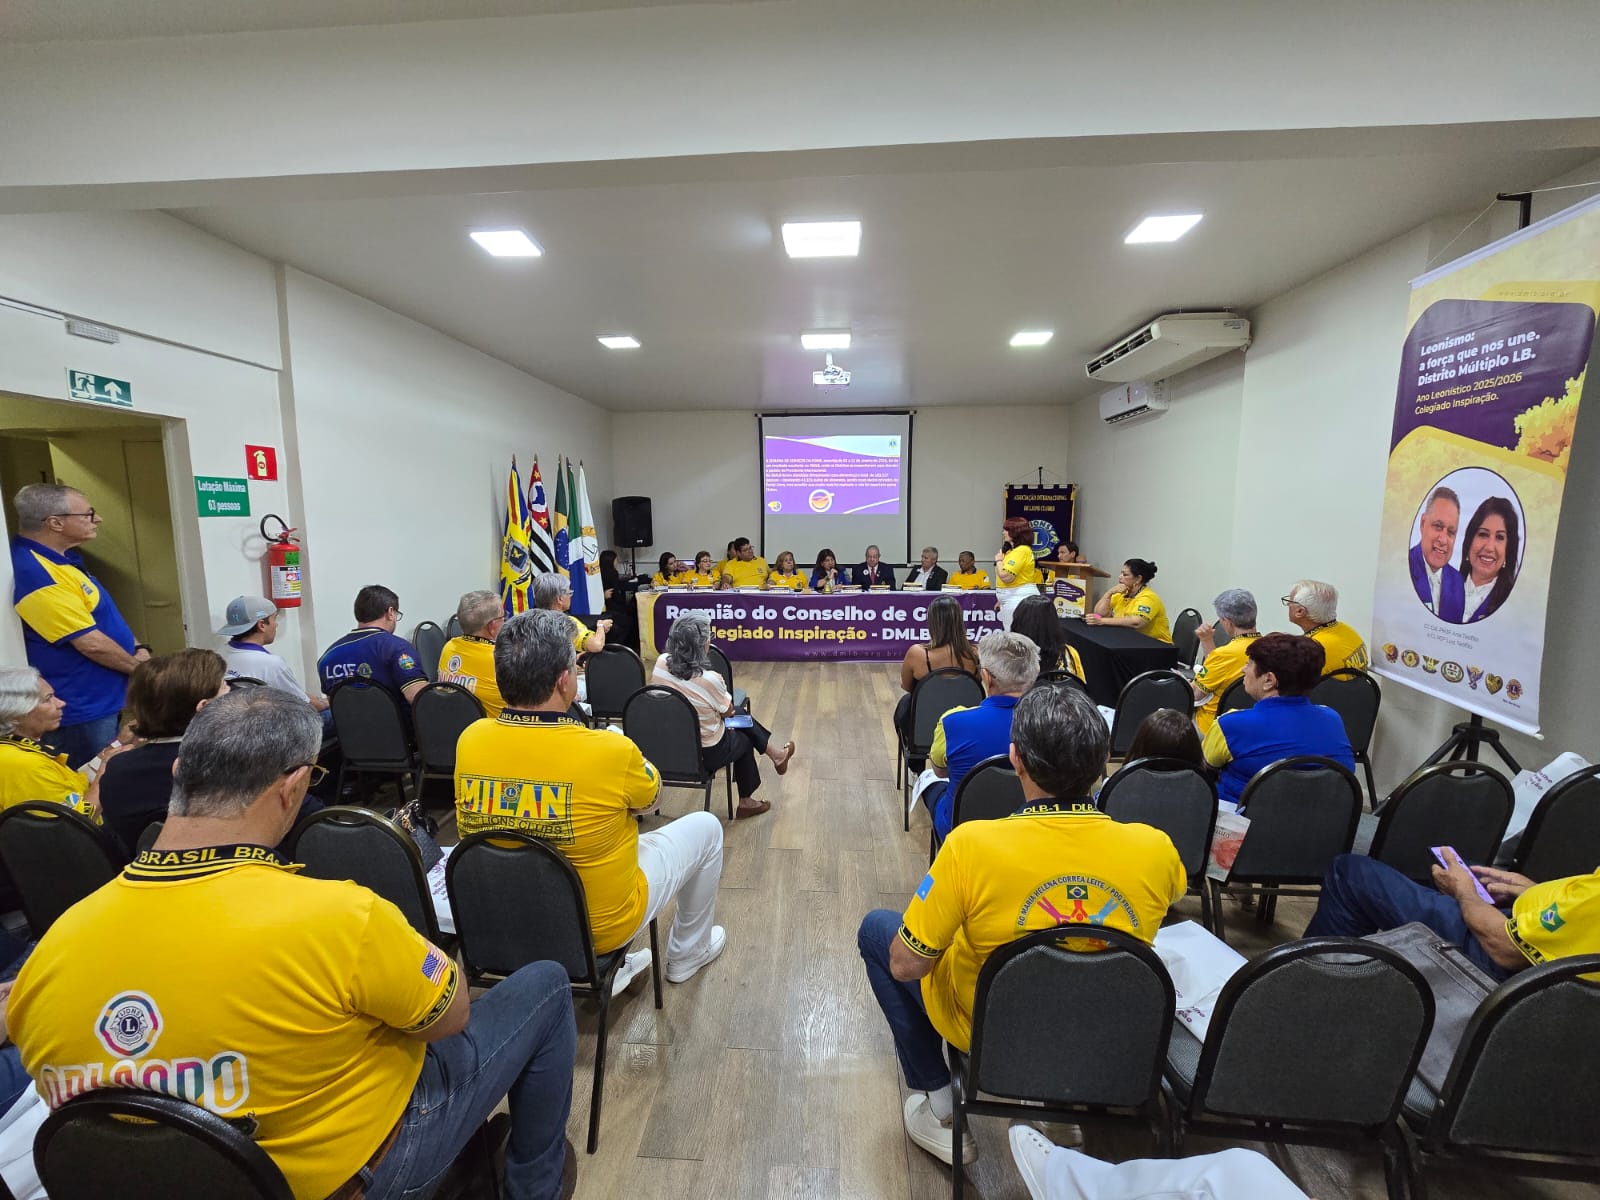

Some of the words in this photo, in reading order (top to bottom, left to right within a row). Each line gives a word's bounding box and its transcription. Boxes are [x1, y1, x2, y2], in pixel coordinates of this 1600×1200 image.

[1419, 362, 1426, 371] a
[1427, 354, 1454, 370] força
[1457, 347, 1479, 363] que
[1481, 339, 1504, 353] nos
[1507, 330, 1541, 346] une.
[1421, 331, 1475, 356] Leonismo:
[1417, 368, 1456, 386] Distrito
[1458, 354, 1509, 376] Múltiplo
[1512, 348, 1536, 364] LB.
[1416, 394, 1430, 403] Ano
[1431, 384, 1472, 399] Leonístico
[1473, 371, 1523, 391] 2025/2026
[1415, 401, 1451, 415] Colegiado
[1452, 392, 1499, 408] Inspiração.
[198, 480, 223, 494] Lotação
[223, 482, 246, 492] Máxima
[208, 500, 217, 511] 63
[217, 502, 241, 512] pessoas
[1030, 520, 1052, 530] IONS
[666, 604, 746, 620] Renião
[752, 606, 777, 620] do
[782, 606, 876, 621] Conselho
[882, 606, 907, 621] de
[711, 625, 774, 641] legiado
[778, 626, 867, 643] Inspiração
[325, 664, 357, 679] LCIF
[501, 712, 540, 722] BRASIL
[461, 778, 563, 818] MILAN
[1023, 804, 1060, 813] DLB-1
[482, 816, 516, 827] LIONS
[518, 820, 562, 834] CLUBS
[139, 849, 222, 864] BRASIL
[1021, 896, 1036, 914] MARIA
[1034, 880, 1057, 897] HELENA
[1086, 877, 1105, 888] LEITE
[120, 1008, 140, 1016] LIONS
[125, 1019, 136, 1032] L
